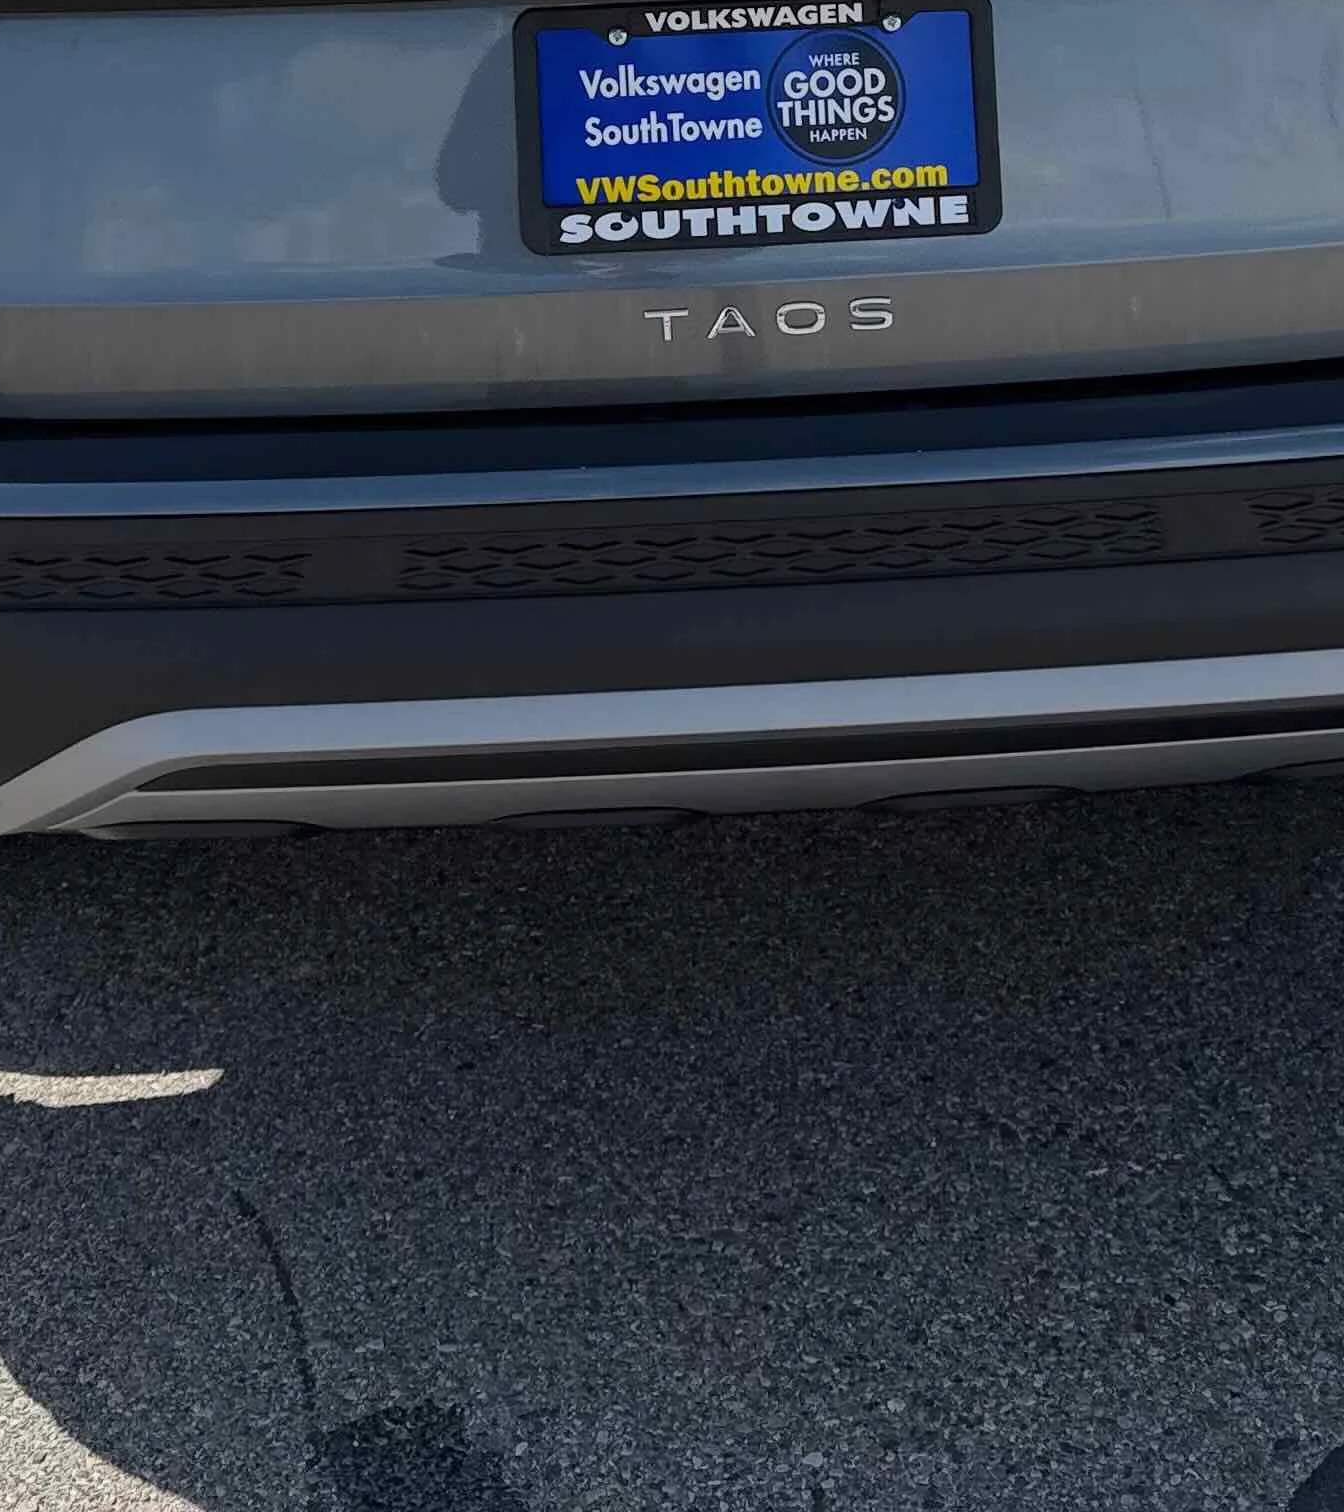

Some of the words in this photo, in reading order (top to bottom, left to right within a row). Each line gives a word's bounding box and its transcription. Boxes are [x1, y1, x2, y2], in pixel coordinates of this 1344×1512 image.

[645, 2, 863, 33] VOLKSWAGEN
[808, 52, 860, 68] WHERE
[579, 64, 762, 102] Volkswagen
[783, 67, 887, 100] GOOD
[584, 110, 764, 148] SouthTowne
[777, 95, 896, 128] THINGS
[809, 127, 868, 143] HAPPEN
[575, 163, 949, 205] VWSouthtowne.com
[559, 195, 969, 244] SOUTHTOWNE
[643, 296, 895, 342] TAOS
